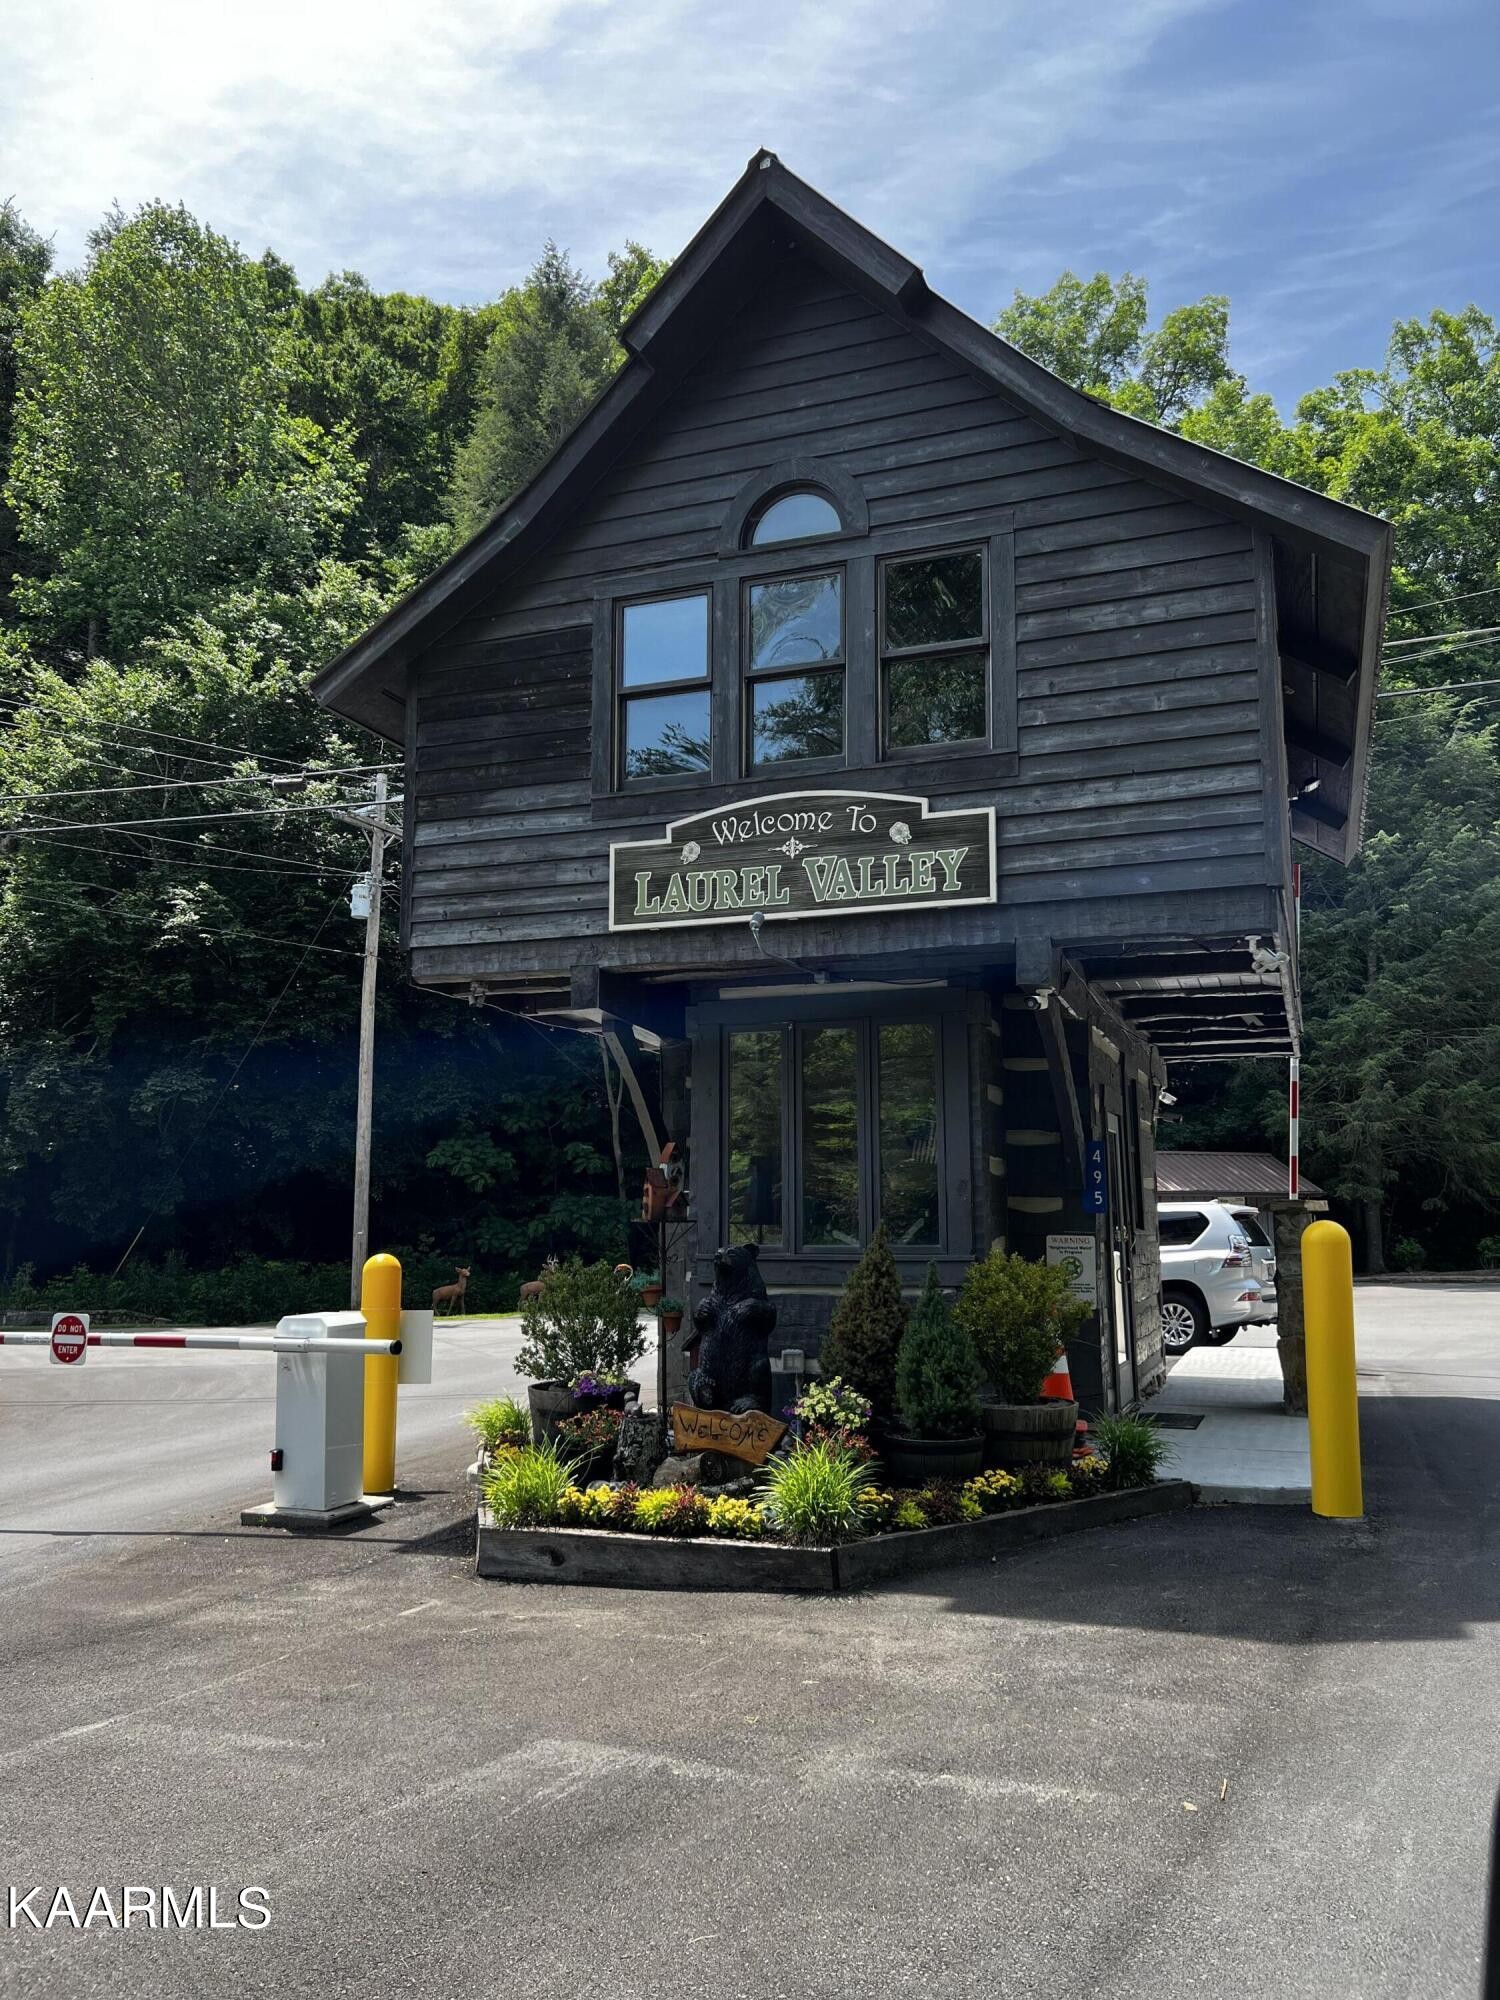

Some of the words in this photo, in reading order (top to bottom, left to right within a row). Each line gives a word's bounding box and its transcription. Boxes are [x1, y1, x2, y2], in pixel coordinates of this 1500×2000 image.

[712, 811, 833, 846] Welcome
[846, 804, 877, 833] To
[634, 865, 789, 915] LAUREL
[802, 847, 969, 902] VALLEY
[1051, 1237, 1090, 1245] WARNING
[57, 1324, 67, 1333] DO
[69, 1325, 82, 1333] NOT
[57, 1345, 78, 1354] ENTER
[679, 1413, 769, 1452] WELCOME
